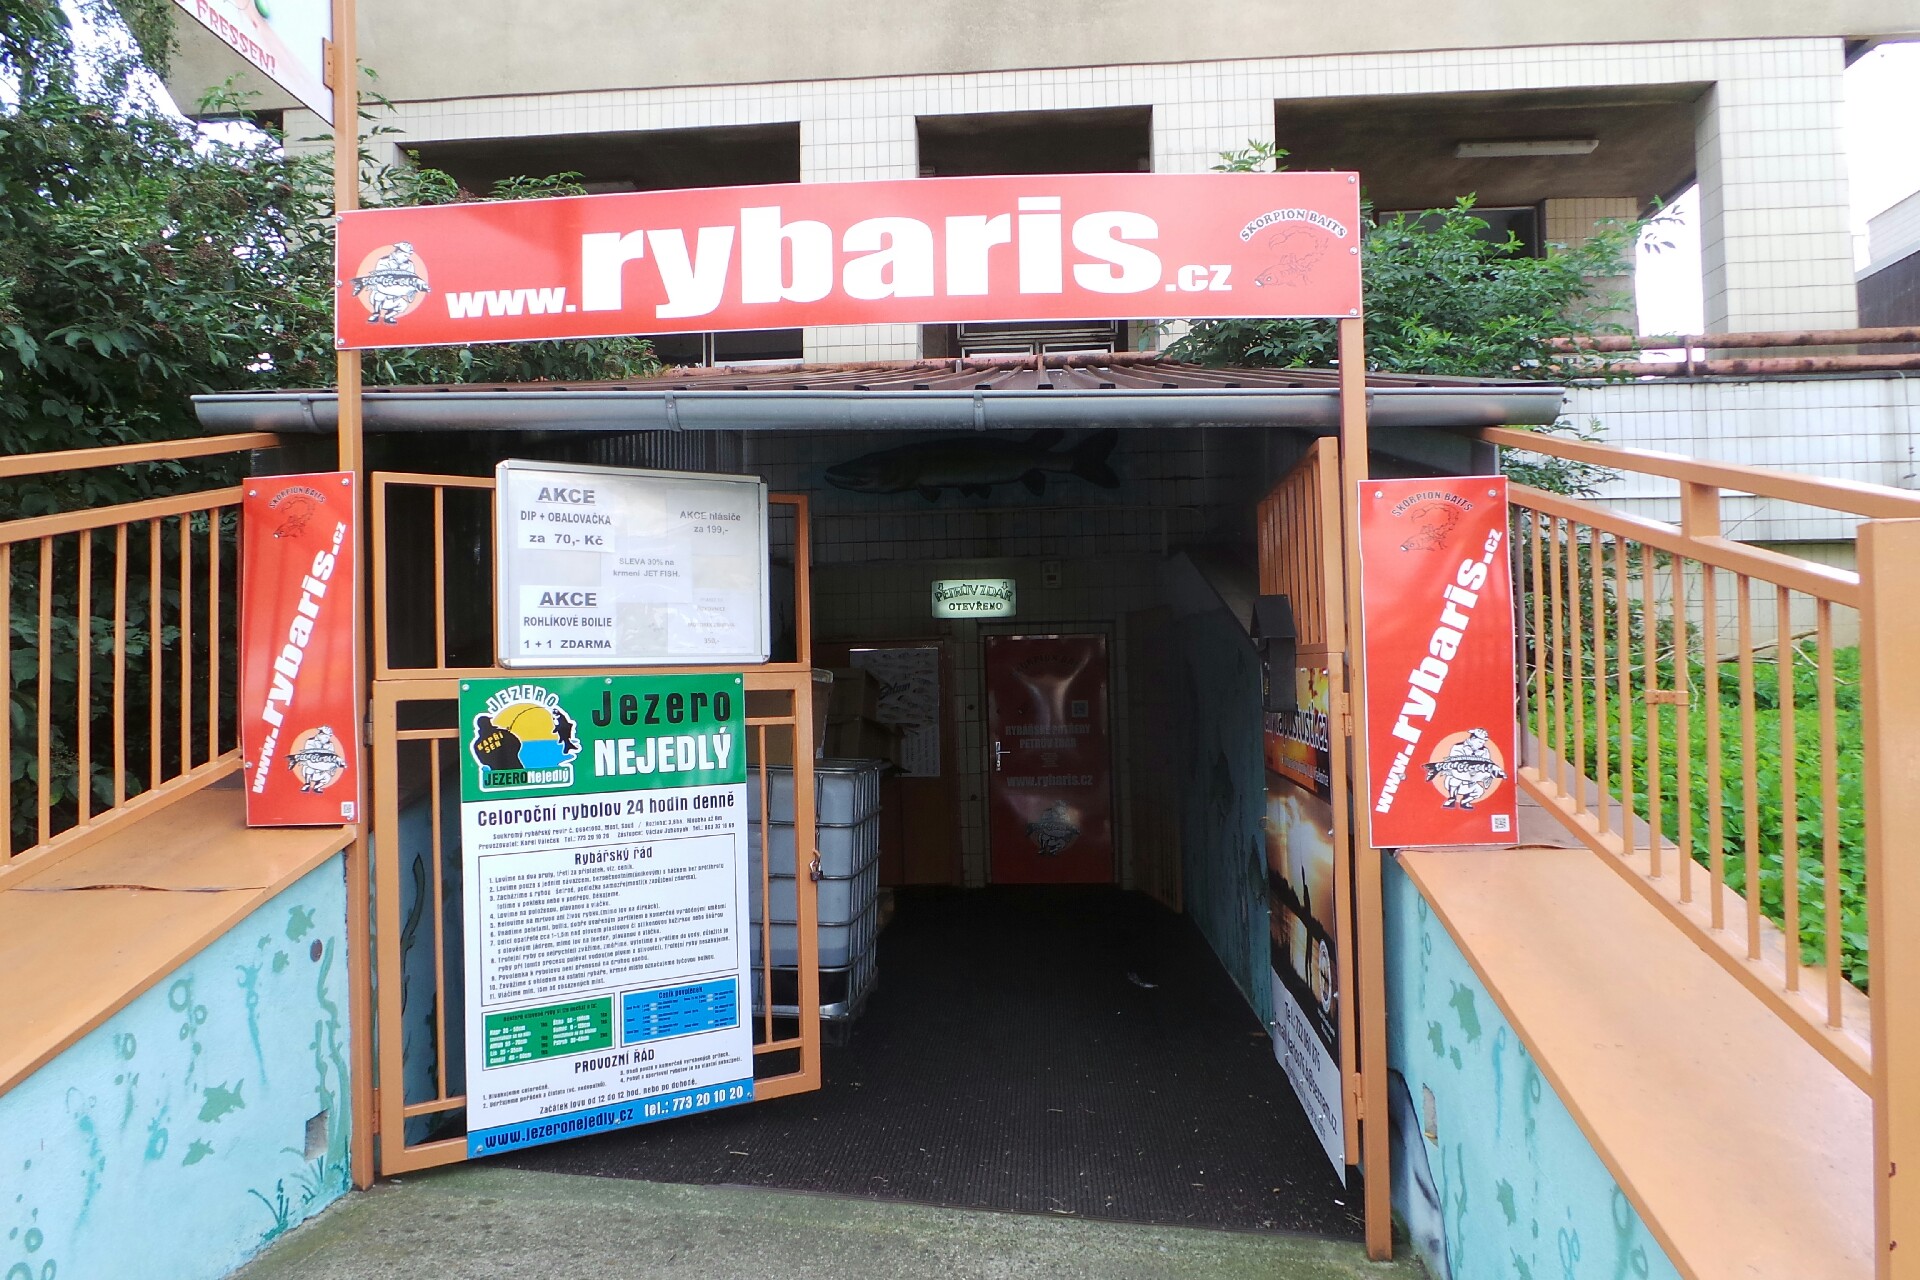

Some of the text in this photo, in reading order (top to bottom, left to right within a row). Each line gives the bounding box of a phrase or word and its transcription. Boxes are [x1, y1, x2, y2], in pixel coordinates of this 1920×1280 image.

[1240, 208, 1348, 242] SKORPION BAITS
[445, 196, 1233, 319] www.rybaris.cz
[269, 487, 326, 509] SKORPION BAITS
[537, 487, 596, 504] AKCE
[1391, 491, 1474, 518] SKORPION BAITS
[520, 510, 537, 521] DIP
[548, 512, 612, 526] OBALOVAČKA
[680, 510, 741, 521] AKCE hlásiče
[529, 533, 604, 546] za 70,- Kč
[707, 525, 729, 535] 199,-
[619, 557, 646, 566] SLEVA
[539, 591, 597, 606] AKCE
[948, 600, 1004, 611] OTEVŘENO
[523, 614, 612, 628] ROHLÍKOVÉ BOILIE
[252, 521, 348, 794] www.rybaris.cz
[523, 639, 530, 649] 1
[546, 639, 552, 649] 1
[560, 639, 612, 649] ZDARMA
[1374, 528, 1503, 815] www.rybaris.cz
[487, 686, 558, 713] JEZERO
[591, 690, 731, 727] Jezero
[594, 726, 731, 777] NEJEDLÝ
[477, 790, 734, 826] Celoroční rybolov 24 hodin denně
[574, 845, 653, 866] Rybářský řád
[574, 1045, 655, 1074] PROVOZNÍ ŘÁD
[539, 1101, 568, 1115] Začátek
[569, 1097, 585, 1109] lovu
[587, 1096, 595, 1106] od
[598, 1094, 605, 1104] 12
[607, 1092, 615, 1102] do
[617, 1090, 624, 1100] 12
[626, 1087, 639, 1098] hod.
[643, 1084, 659, 1095] nebo
[661, 1082, 669, 1092] po
[644, 1085, 743, 1117] tel.: 773 20 10 20
[484, 1107, 635, 1148] www.jezeronejedly.cz
